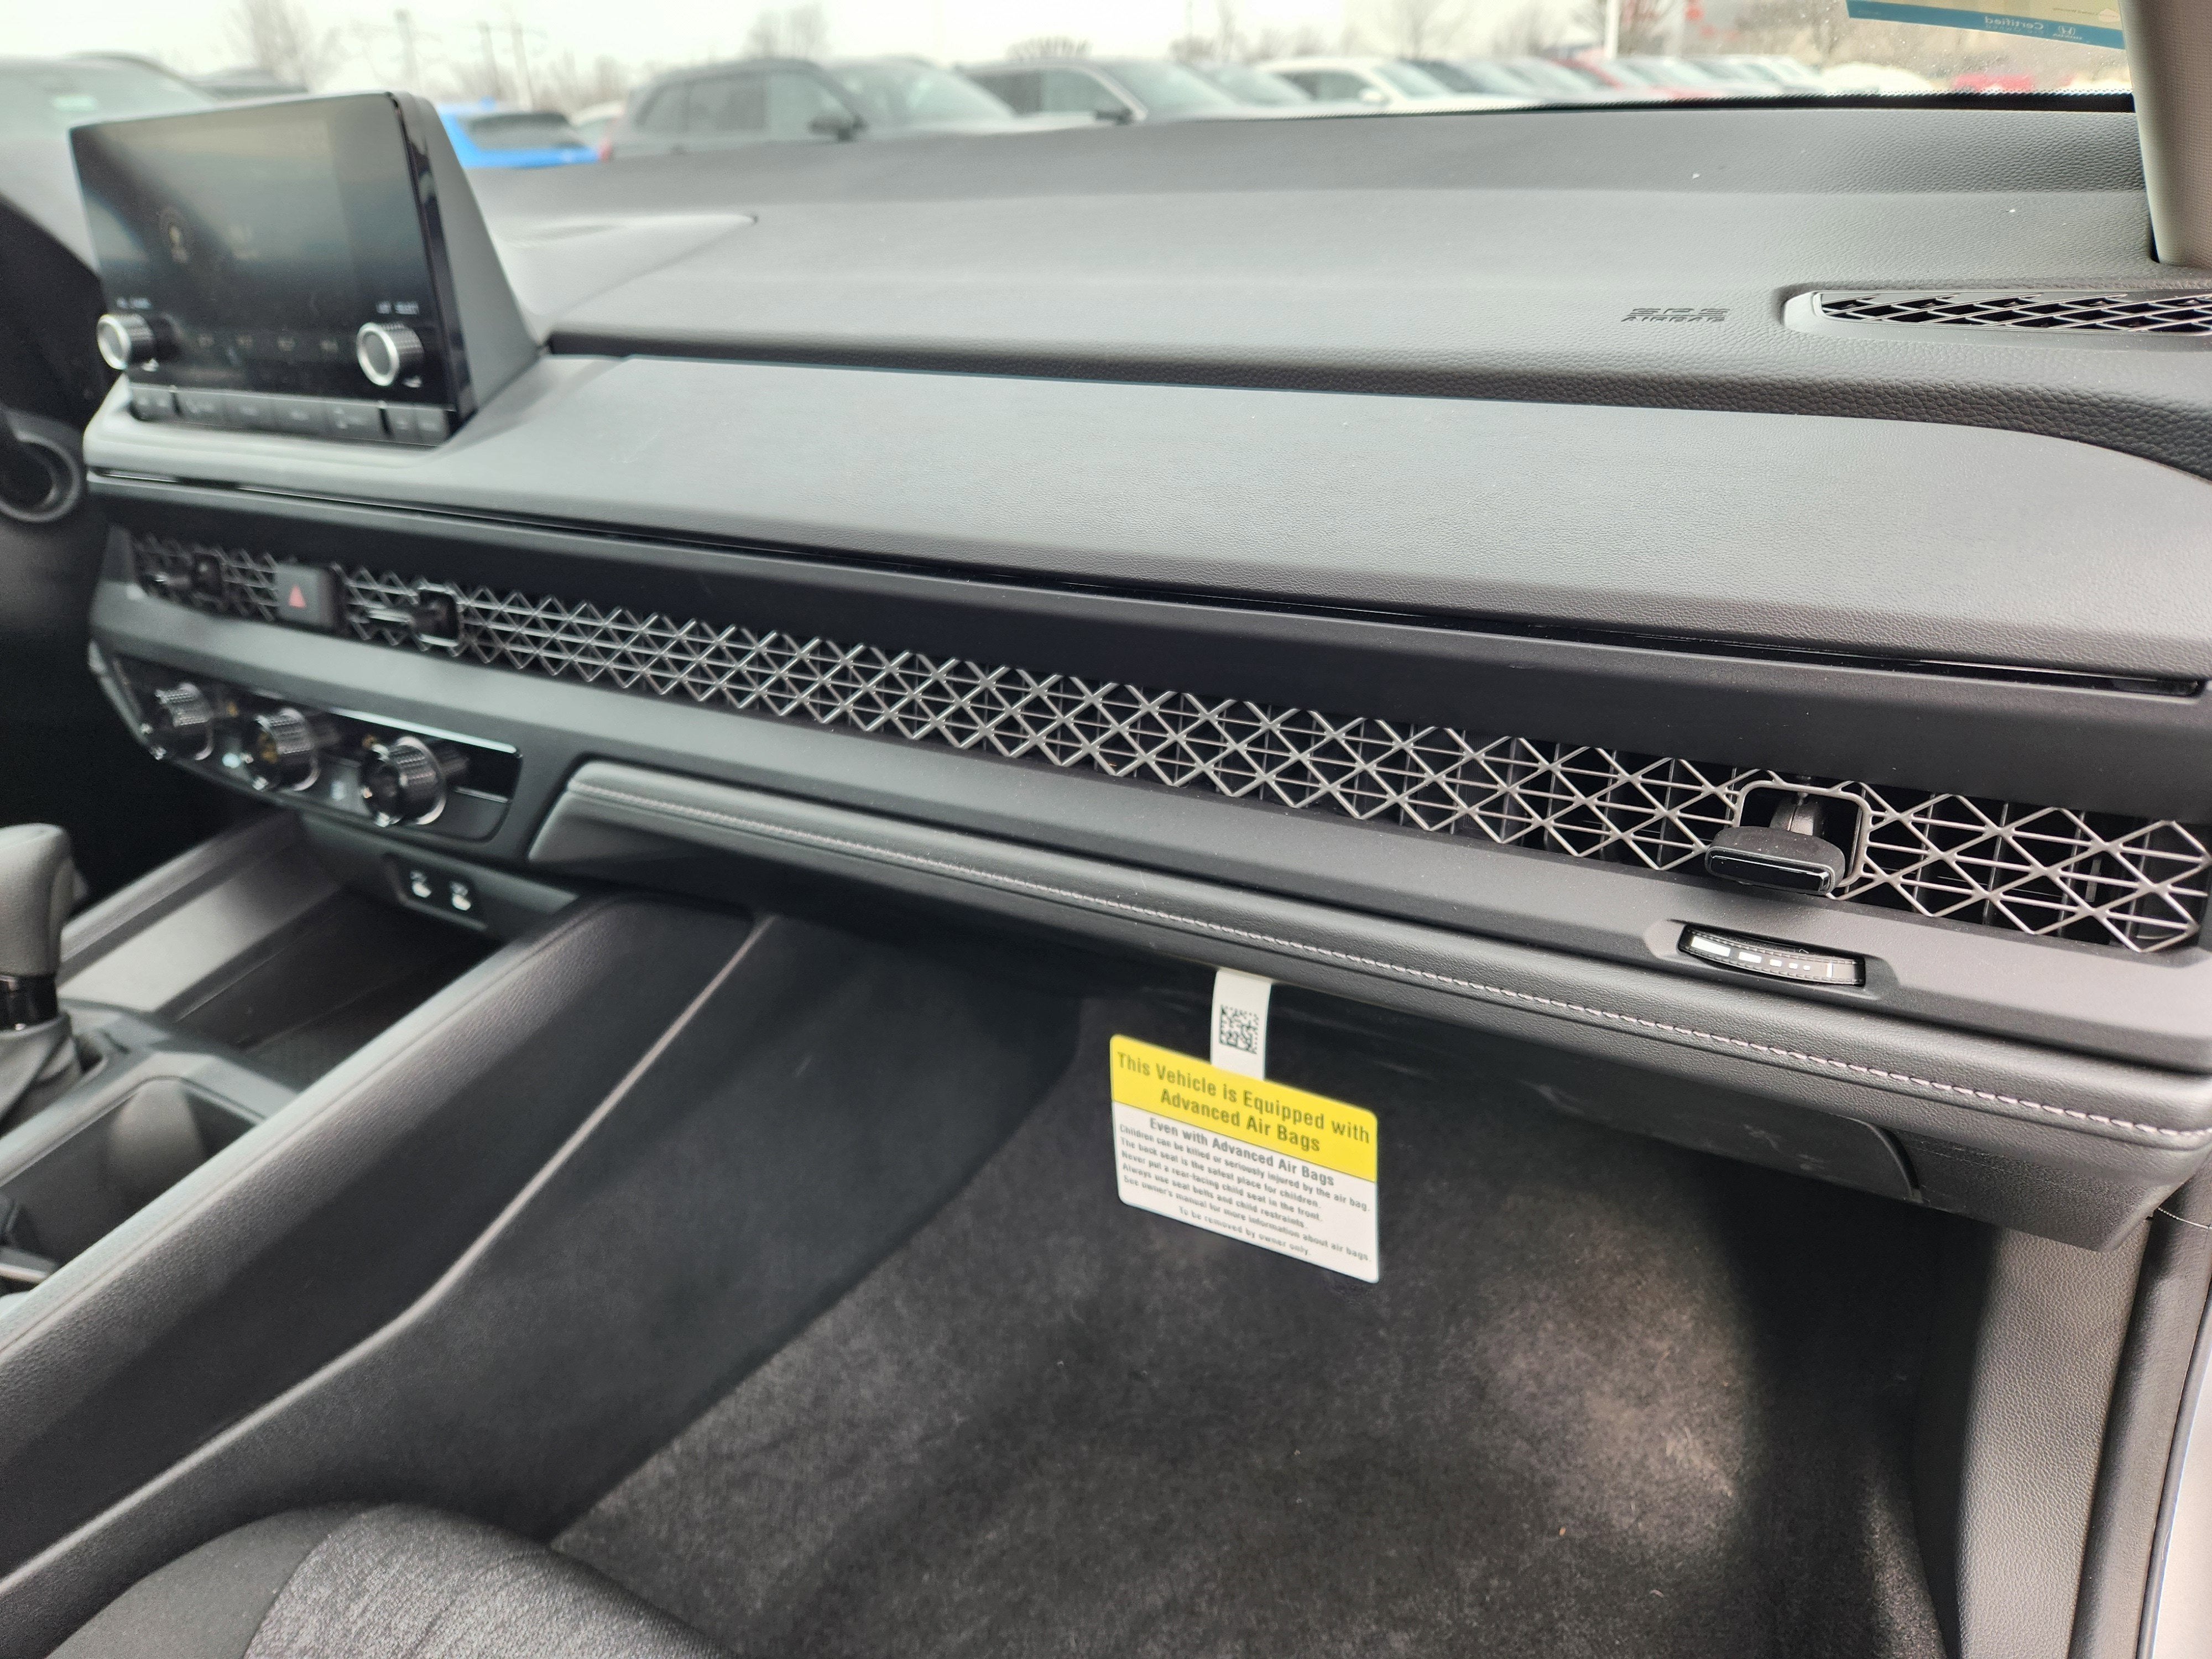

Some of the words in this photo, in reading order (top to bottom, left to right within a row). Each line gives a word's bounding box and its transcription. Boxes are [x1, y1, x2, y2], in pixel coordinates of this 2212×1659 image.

[1118, 1052, 1150, 1076] This
[1156, 1063, 1216, 1096] Vehicle
[1223, 1083, 1237, 1103] is
[1243, 1090, 1324, 1130] Equipped
[1331, 1120, 1370, 1144] with
[1161, 1088, 1240, 1126] Advanced
[1246, 1115, 1271, 1136] Air
[1277, 1124, 1320, 1151] Bags
[1120, 1124, 1154, 1142] Children
[1157, 1137, 1171, 1148] can
[1174, 1141, 1184, 1152] be
[1187, 1145, 1211, 1160] killed
[1224, 1159, 1265, 1178] seriously
[1268, 1171, 1300, 1188] injured
[1302, 1182, 1313, 1194] by
[1316, 1187, 1331, 1198] the
[1334, 1193, 1347, 1203] air
[1349, 1197, 1370, 1212] bag.
[1120, 1136, 1135, 1149] The
[1139, 1142, 1157, 1156] back
[1160, 1151, 1178, 1162] seat
[1182, 1156, 1188, 1166] is
[1191, 1159, 1204, 1171] the
[1207, 1165, 1234, 1181] safest
[1237, 1175, 1261, 1190] place
[1264, 1183, 1276, 1194] for
[1280, 1190, 1321, 1208] children.
[1121, 1150, 1145, 1164] Never
[1149, 1159, 1161, 1171] put
[1172, 1167, 1219, 1190] rear-facing
[1222, 1183, 1244, 1196] child
[1246, 1191, 1266, 1203] seat
[1269, 1197, 1277, 1207] in
[1280, 1201, 1295, 1212] the
[1298, 1207, 1322, 1221] front.
[1150, 1117, 1178, 1136] Even
[1182, 1129, 1208, 1146] with
[1212, 1138, 1273, 1167] Advanced
[1278, 1158, 1297, 1174] Air
[1301, 1165, 1334, 1186] Bags
[1123, 1162, 1152, 1178] Always
[1155, 1174, 1169, 1184] use
[1172, 1179, 1190, 1191] seat
[1193, 1185, 1214, 1199] belts
[1217, 1193, 1233, 1205] and
[1235, 1199, 1258, 1213] child
[1261, 1208, 1308, 1229] restraints.
[1124, 1175, 1139, 1186] See
[1176, 1193, 1207, 1208] manual
[1209, 1202, 1220, 1213] for
[1224, 1208, 1246, 1220] more
[1249, 1214, 1300, 1238] information
[1303, 1233, 1328, 1248] about
[1331, 1243, 1343, 1252] air
[1346, 1246, 1372, 1261] bags.
[1178, 1206, 1188, 1216] To
[1191, 1209, 1201, 1220] be
[1204, 1215, 1243, 1233] removed
[1245, 1227, 1255, 1239] by
[1258, 1232, 1286, 1247] owner
